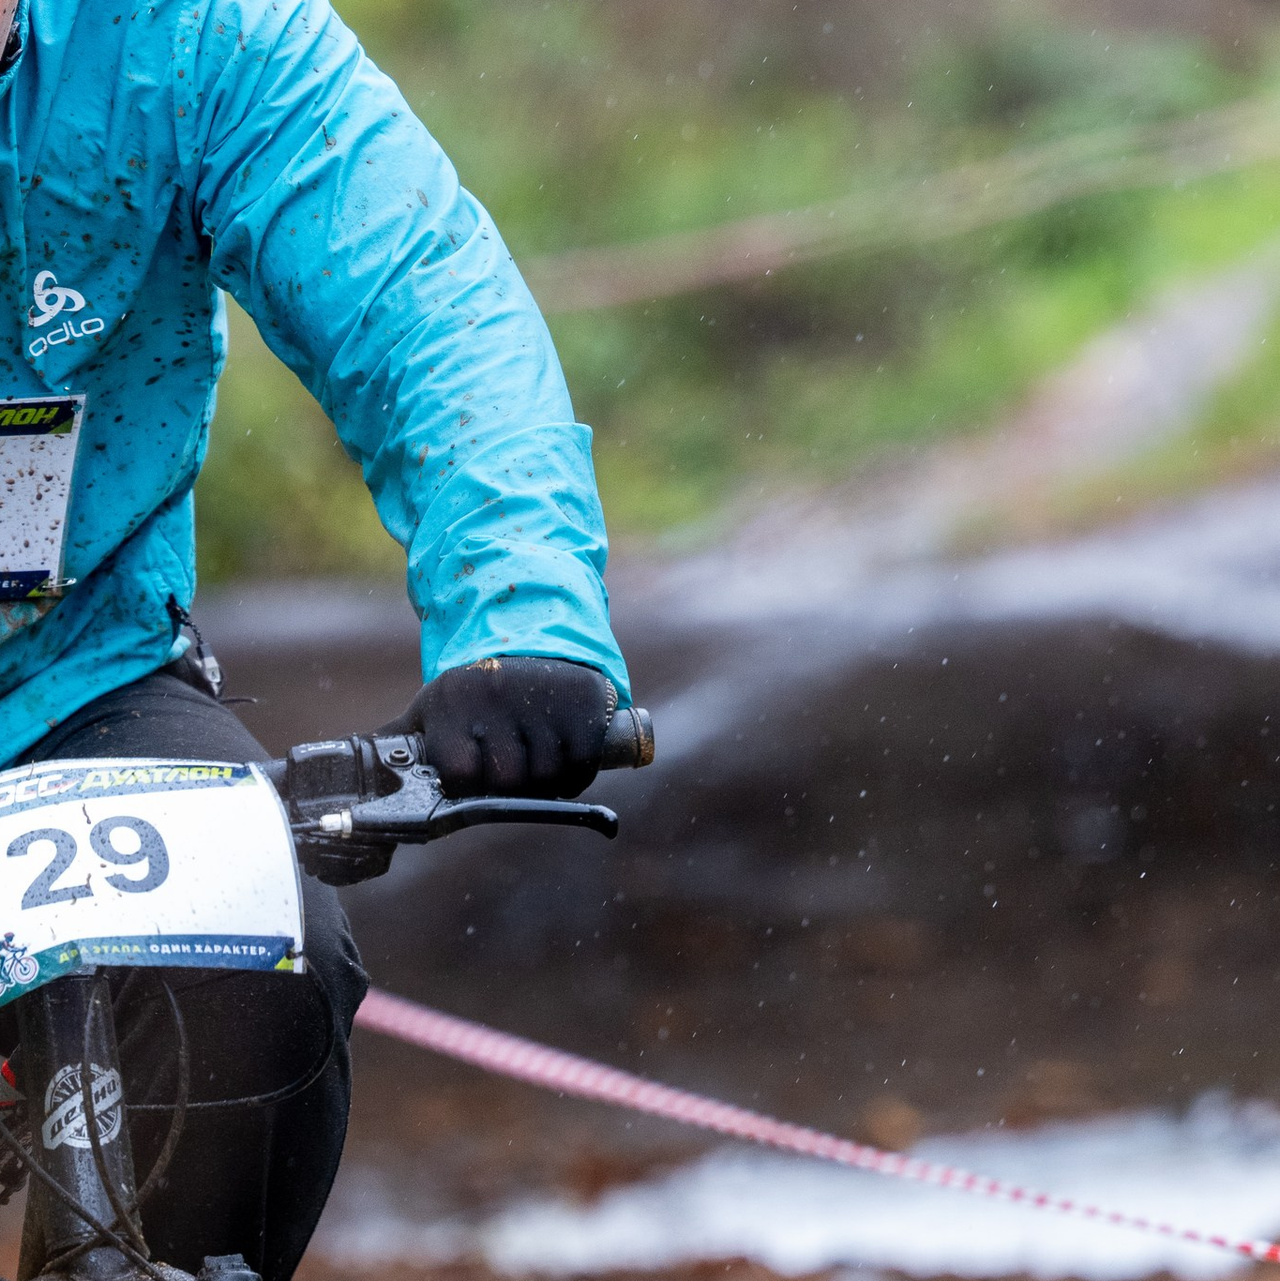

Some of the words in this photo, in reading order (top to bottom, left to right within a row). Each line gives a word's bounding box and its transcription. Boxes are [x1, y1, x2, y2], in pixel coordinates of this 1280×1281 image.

[77, 765, 233, 793] ДУАТЛОН
[5, 815, 171, 911] 29
[149, 943, 192, 955] ОДИН
